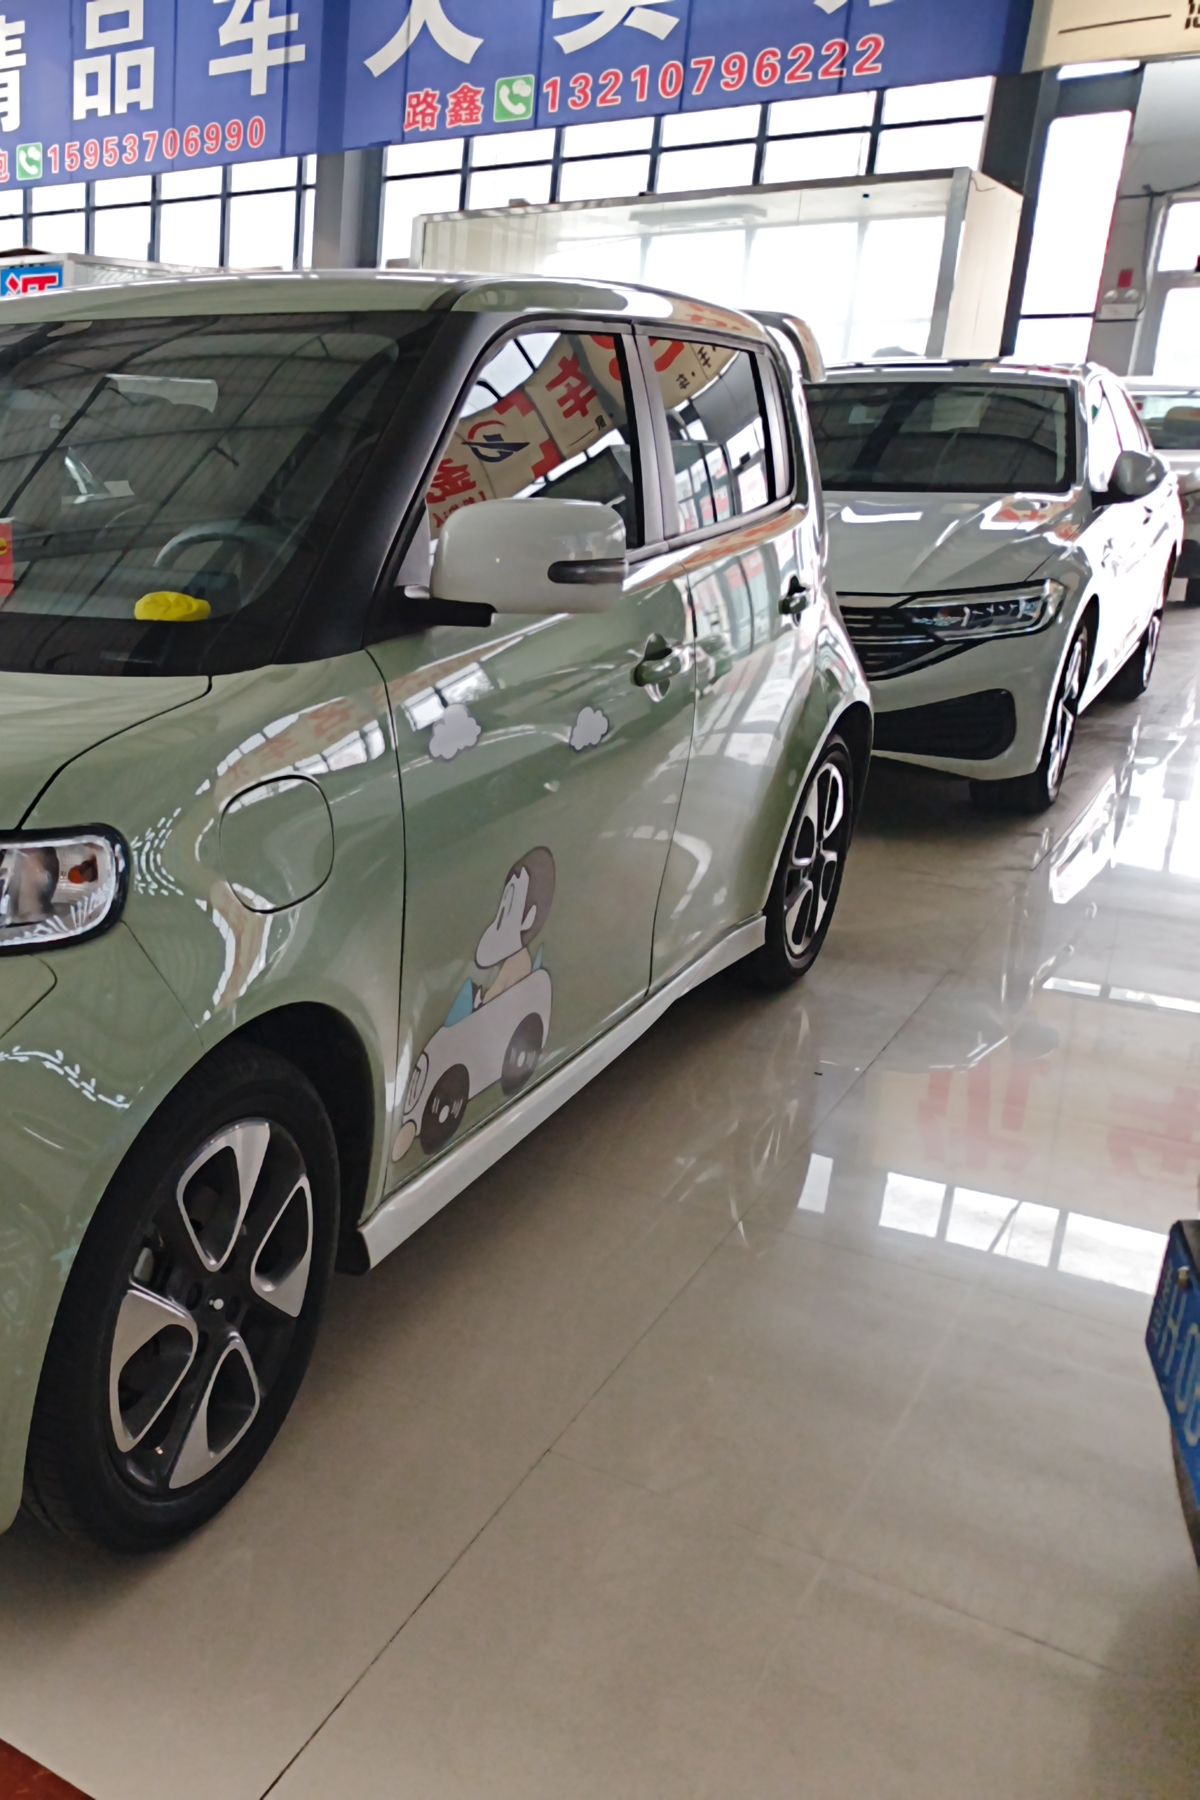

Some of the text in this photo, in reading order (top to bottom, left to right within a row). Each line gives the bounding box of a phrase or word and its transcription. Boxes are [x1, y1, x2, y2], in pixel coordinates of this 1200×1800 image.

[403, 34, 886, 133] 路鑫 13210796222
[47, 115, 266, 175] 15953706990
